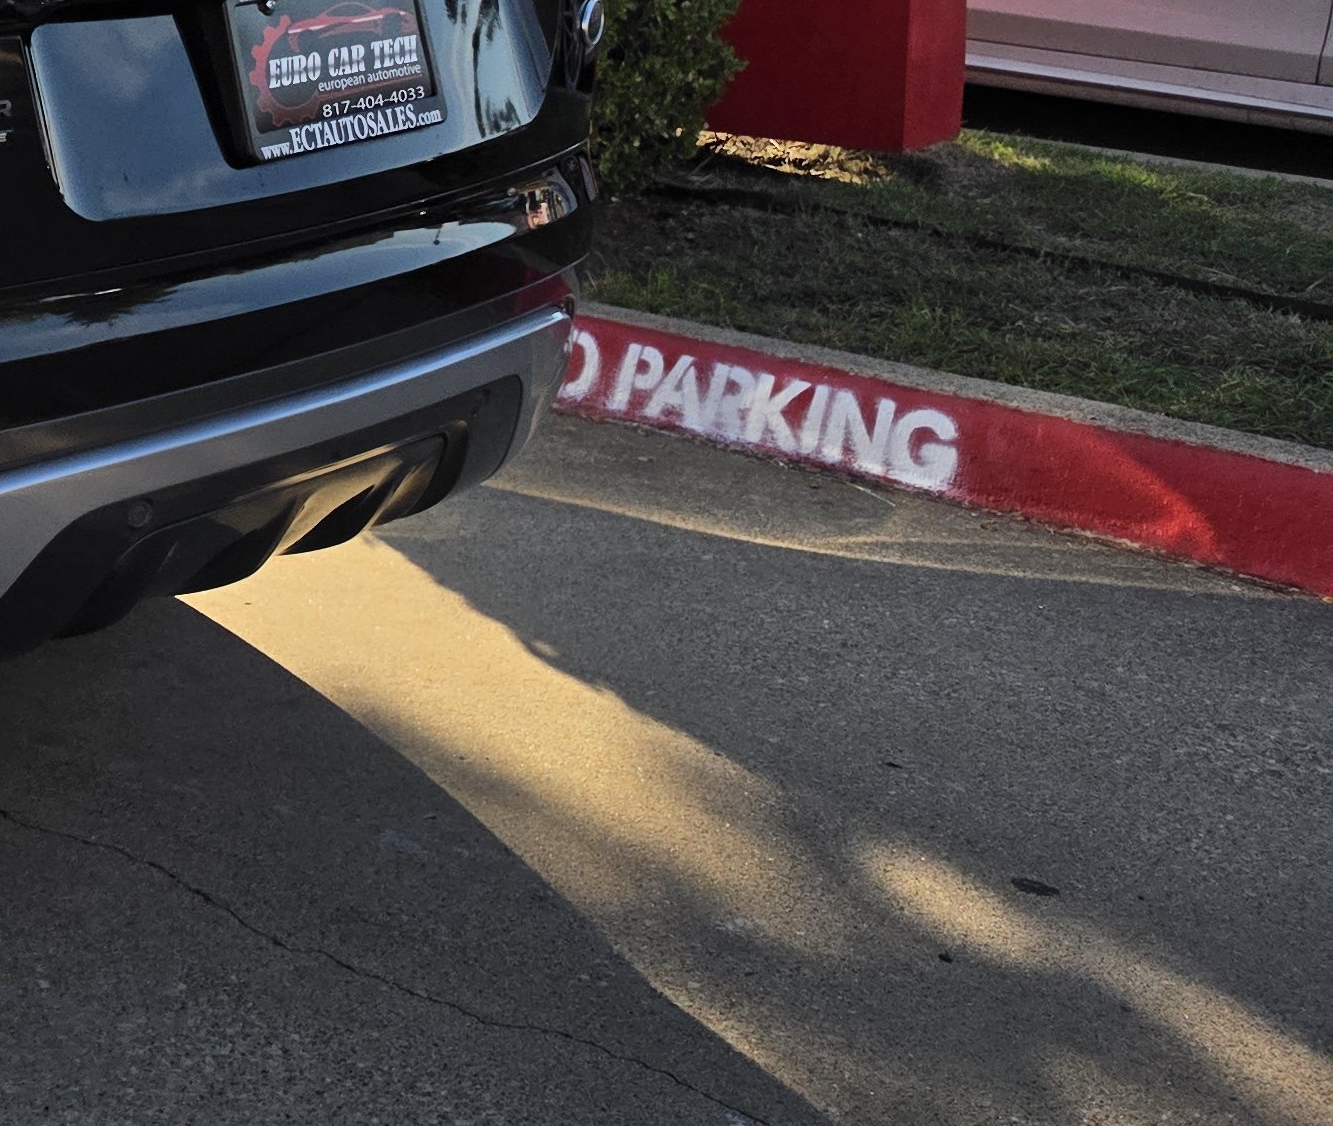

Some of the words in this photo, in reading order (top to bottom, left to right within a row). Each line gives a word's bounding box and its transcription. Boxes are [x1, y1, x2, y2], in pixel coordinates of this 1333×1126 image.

[269, 51, 321, 89] EURO
[328, 44, 366, 77] CAR
[371, 34, 419, 69] TECH
[318, 74, 366, 92] european
[367, 63, 422, 83] automotive
[322, 85, 426, 118] 817-404-4033
[261, 103, 442, 161] www.ECTAUTOSALES.com
[607, 342, 959, 491] PARKING
